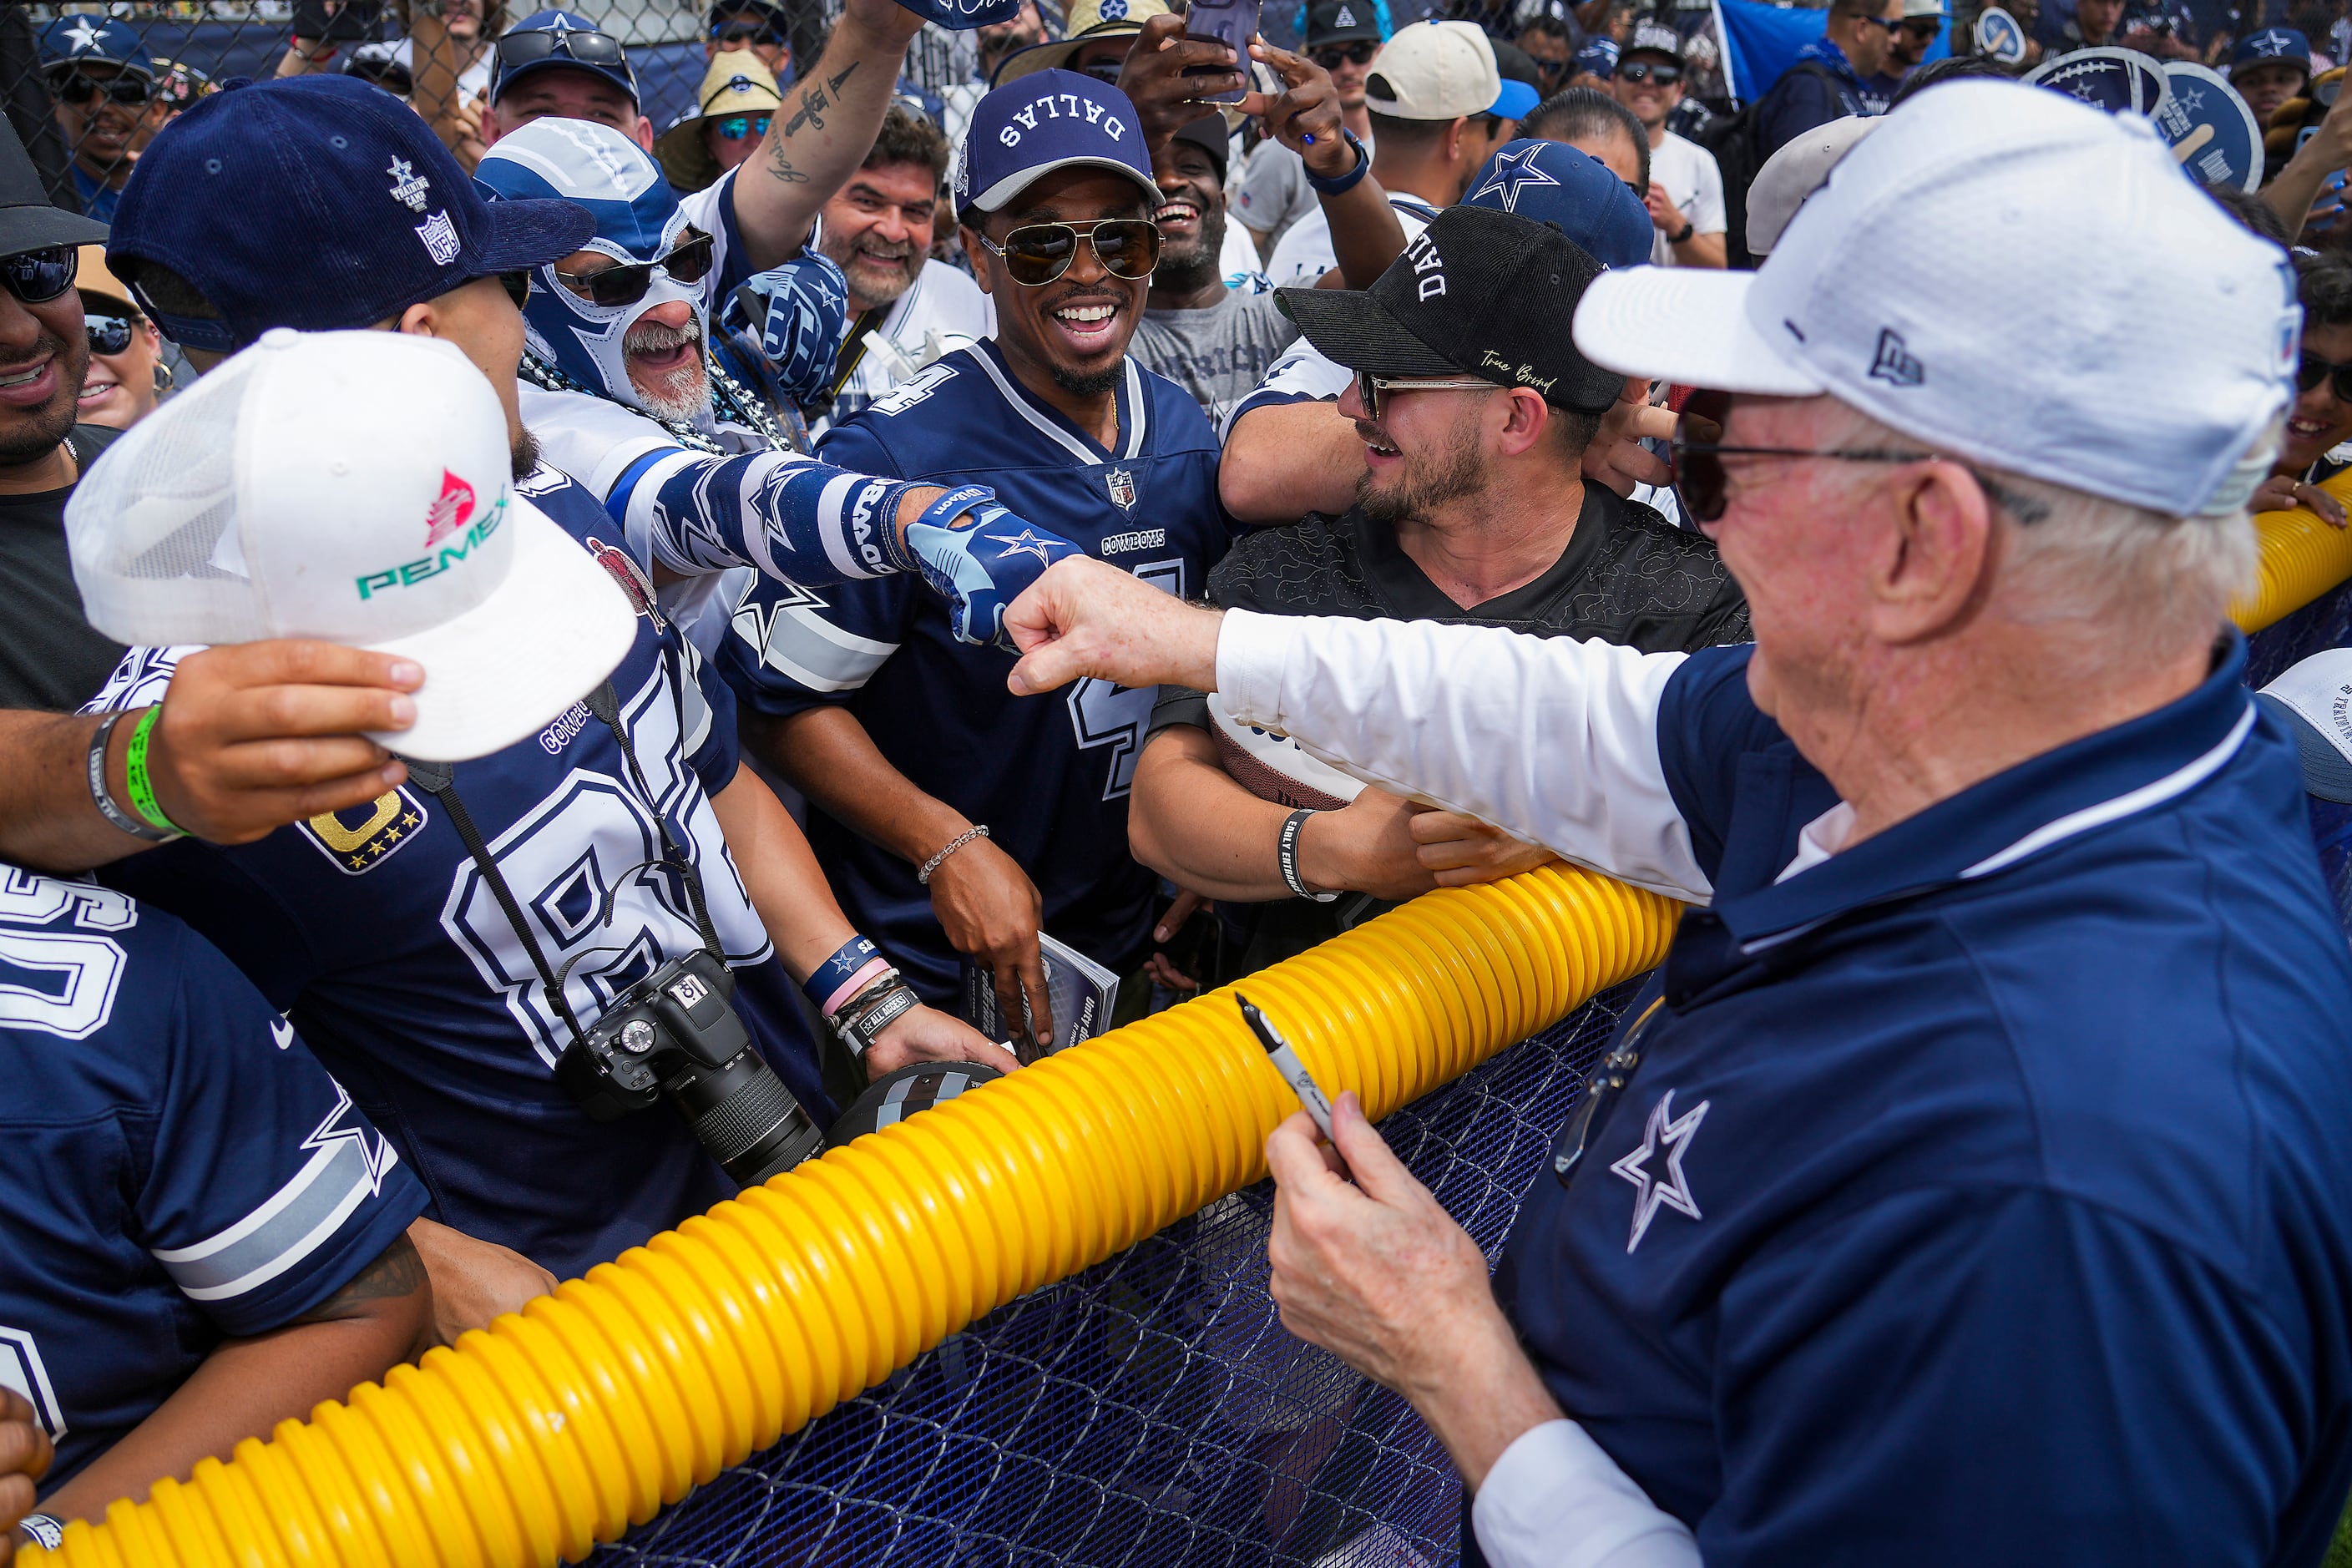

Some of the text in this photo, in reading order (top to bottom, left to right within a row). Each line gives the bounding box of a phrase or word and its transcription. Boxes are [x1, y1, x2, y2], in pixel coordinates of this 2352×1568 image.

[999, 94, 1126, 148] DALLAS
[392, 178, 430, 200] TRAINING
[405, 190, 427, 208] CAMP
[430, 230, 458, 260] NFL
[1480, 349, 1511, 372] True
[933, 488, 987, 516] Wilson
[1112, 485, 1134, 506] NFL
[357, 483, 508, 601] PEMEX
[1101, 528, 1166, 556] COWBOYS
[539, 700, 592, 755] COWBO
[2334, 696, 2352, 744] TRAININ
[1282, 820, 1297, 851] EARLY
[870, 995, 907, 1026] ALL ACCESS
[1080, 995, 1095, 1028] Unity
[725, 1052, 746, 1071] 200 300
